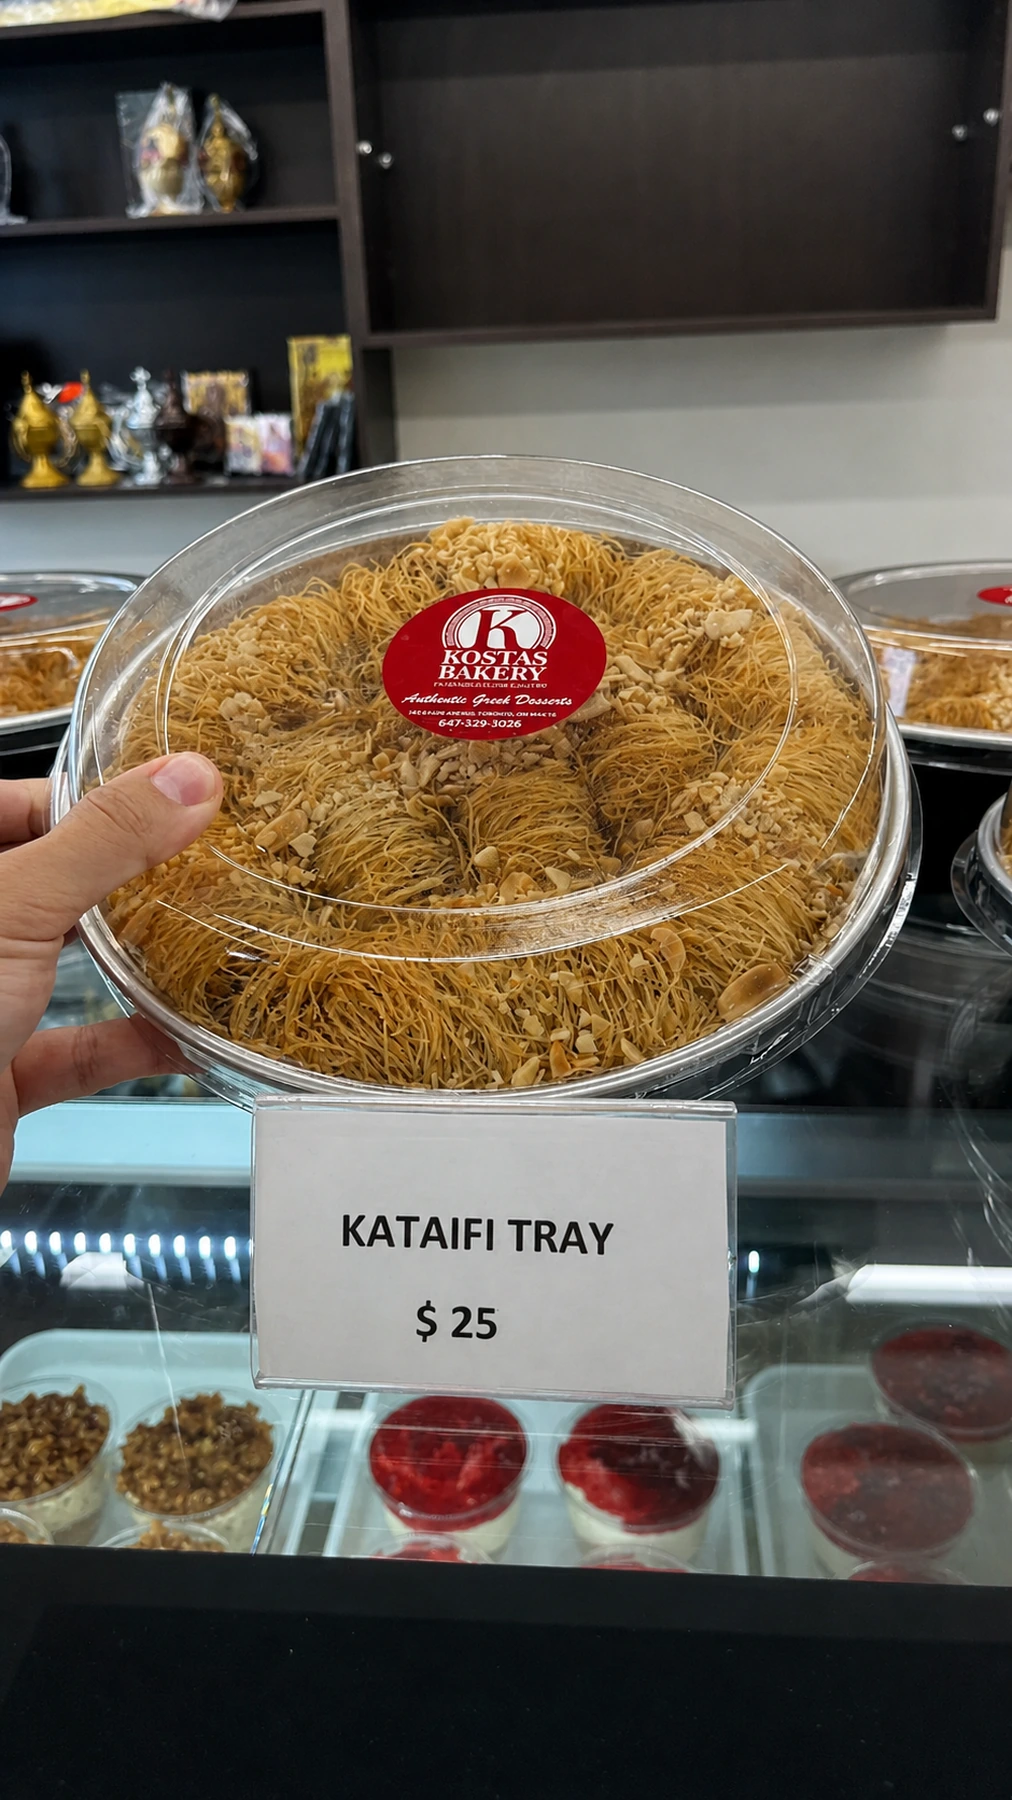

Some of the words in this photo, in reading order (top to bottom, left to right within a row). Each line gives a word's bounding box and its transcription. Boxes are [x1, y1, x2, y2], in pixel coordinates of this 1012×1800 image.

[441, 649, 548, 666] KOSTAS
[438, 665, 548, 681] BAKERY
[401, 692, 467, 705] Authentic
[472, 693, 511, 707] Greek
[515, 694, 573, 706] Desserts
[438, 718, 522, 728] 647-329-3026
[342, 1214, 494, 1251] KATAIFI
[507, 1218, 615, 1255] TRAY
[415, 1299, 438, 1342] $
[451, 1305, 498, 1340] 25
